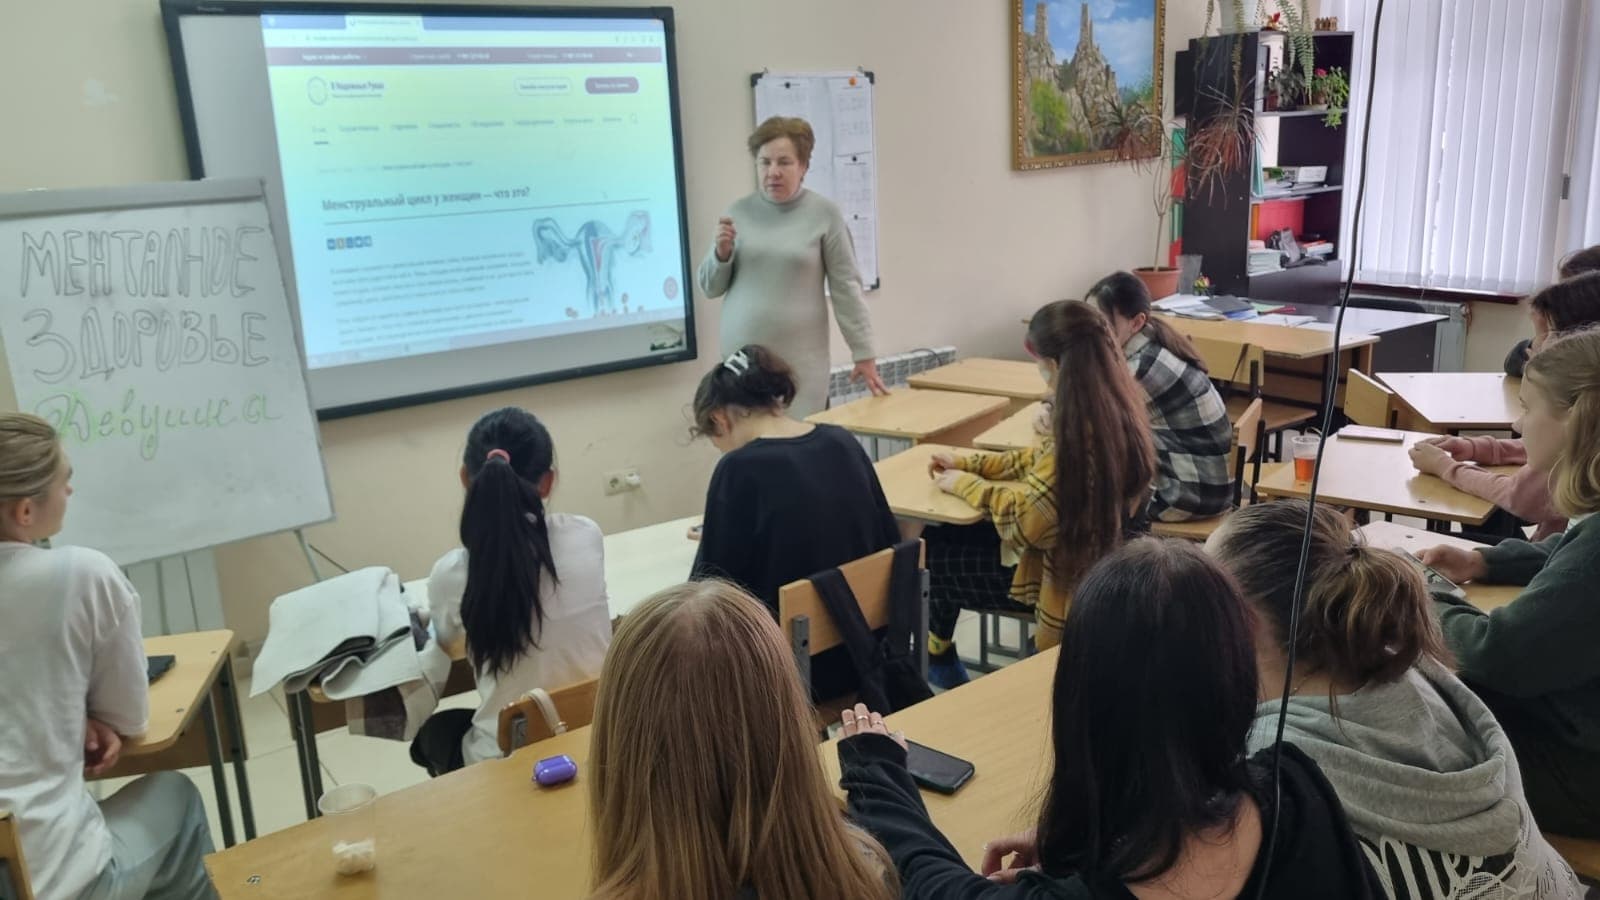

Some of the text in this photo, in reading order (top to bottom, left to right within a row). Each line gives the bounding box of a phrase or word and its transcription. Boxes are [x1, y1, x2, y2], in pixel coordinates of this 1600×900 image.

[322, 194, 405, 212] Менструальный
[407, 195, 432, 206] цикл
[442, 192, 481, 203] женщин
[494, 190, 509, 199] что
[511, 187, 530, 198] это?
[22, 307, 270, 384] ЗДОРОВЬЕ
[34, 389, 281, 460] Девушка
